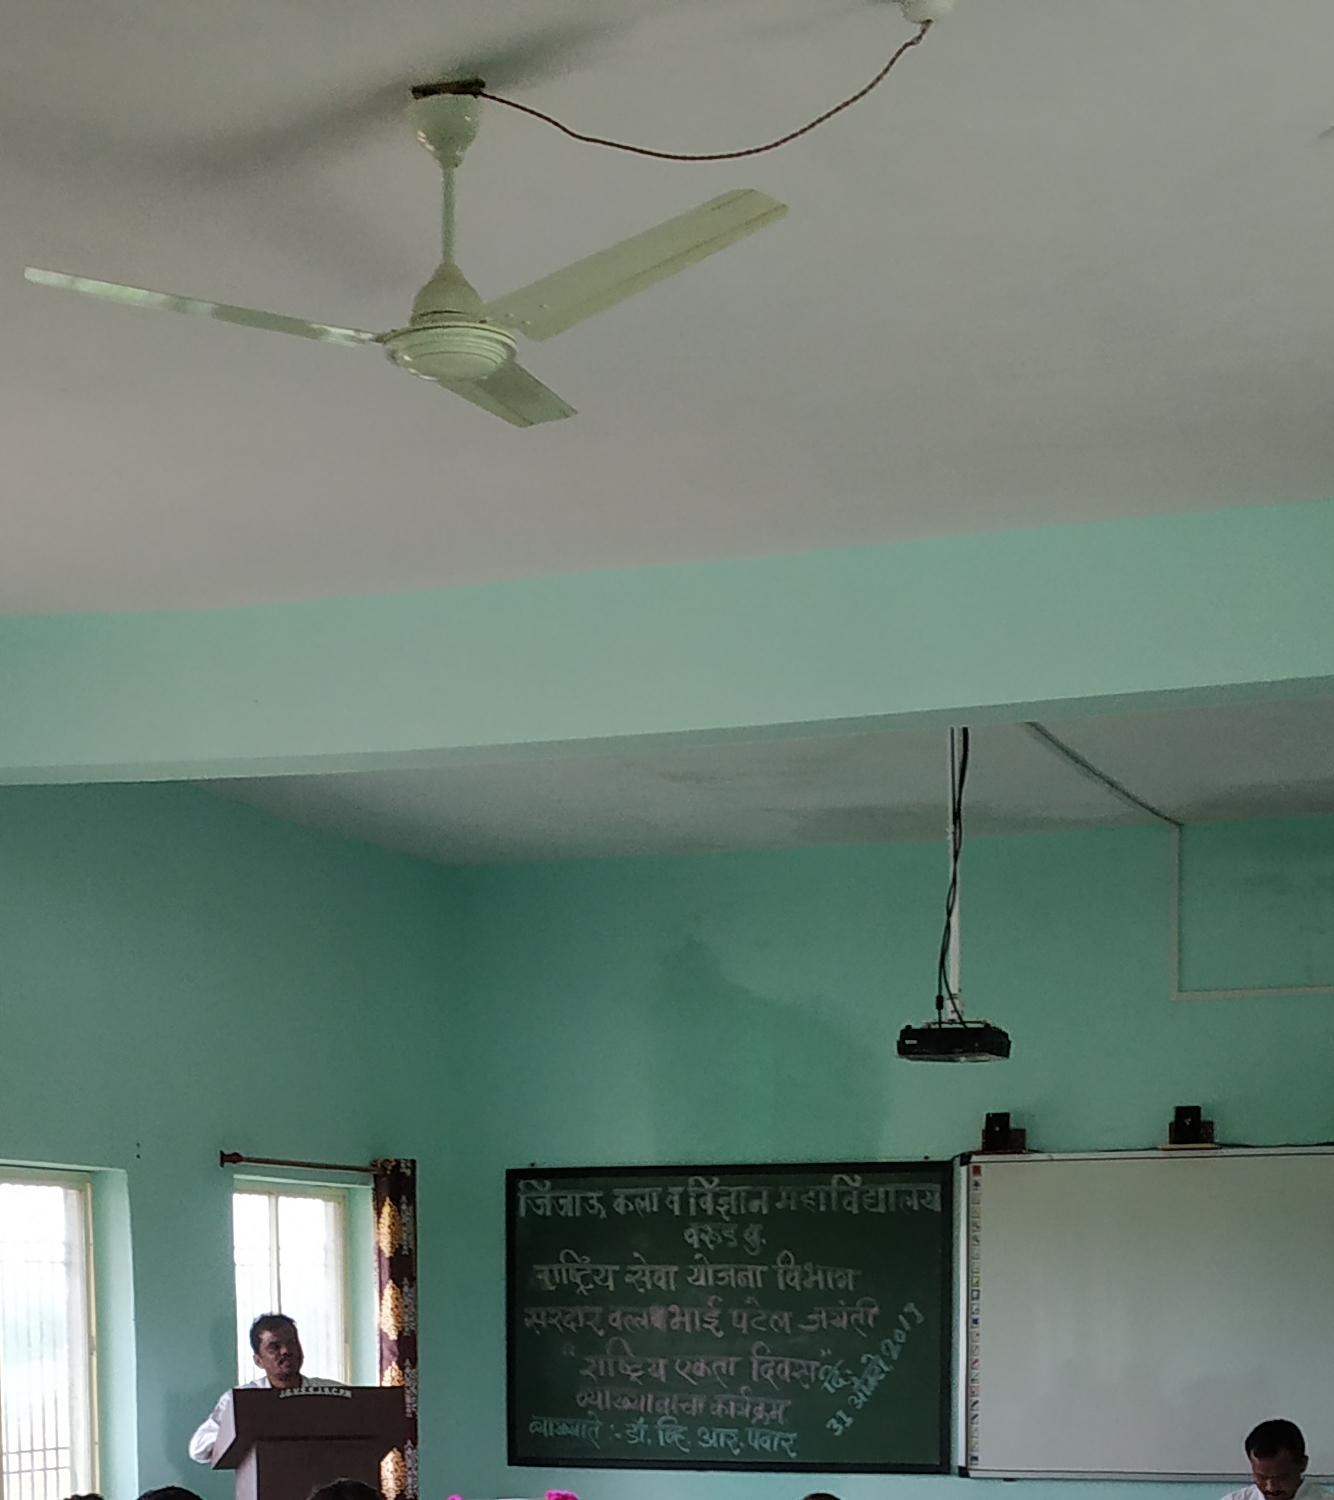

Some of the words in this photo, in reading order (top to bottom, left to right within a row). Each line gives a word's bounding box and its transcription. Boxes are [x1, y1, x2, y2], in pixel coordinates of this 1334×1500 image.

[612, 1187, 663, 1218] कला
[666, 1186, 685, 1216] व
[686, 1175, 768, 1222] विज्ञान
[775, 1174, 942, 1216] महाविद्यालय
[624, 1252, 678, 1294] सेवा
[686, 1253, 768, 1289] योजना
[771, 1250, 861, 1292] विभाग
[524, 1306, 606, 1337] सरदार
[729, 1297, 792, 1335] पटेल
[798, 1297, 880, 1337] जयंती
[673, 1355, 742, 1389] एकता
[825, 1410, 855, 1436] 31
[746, 1427, 798, 1458] पवार
